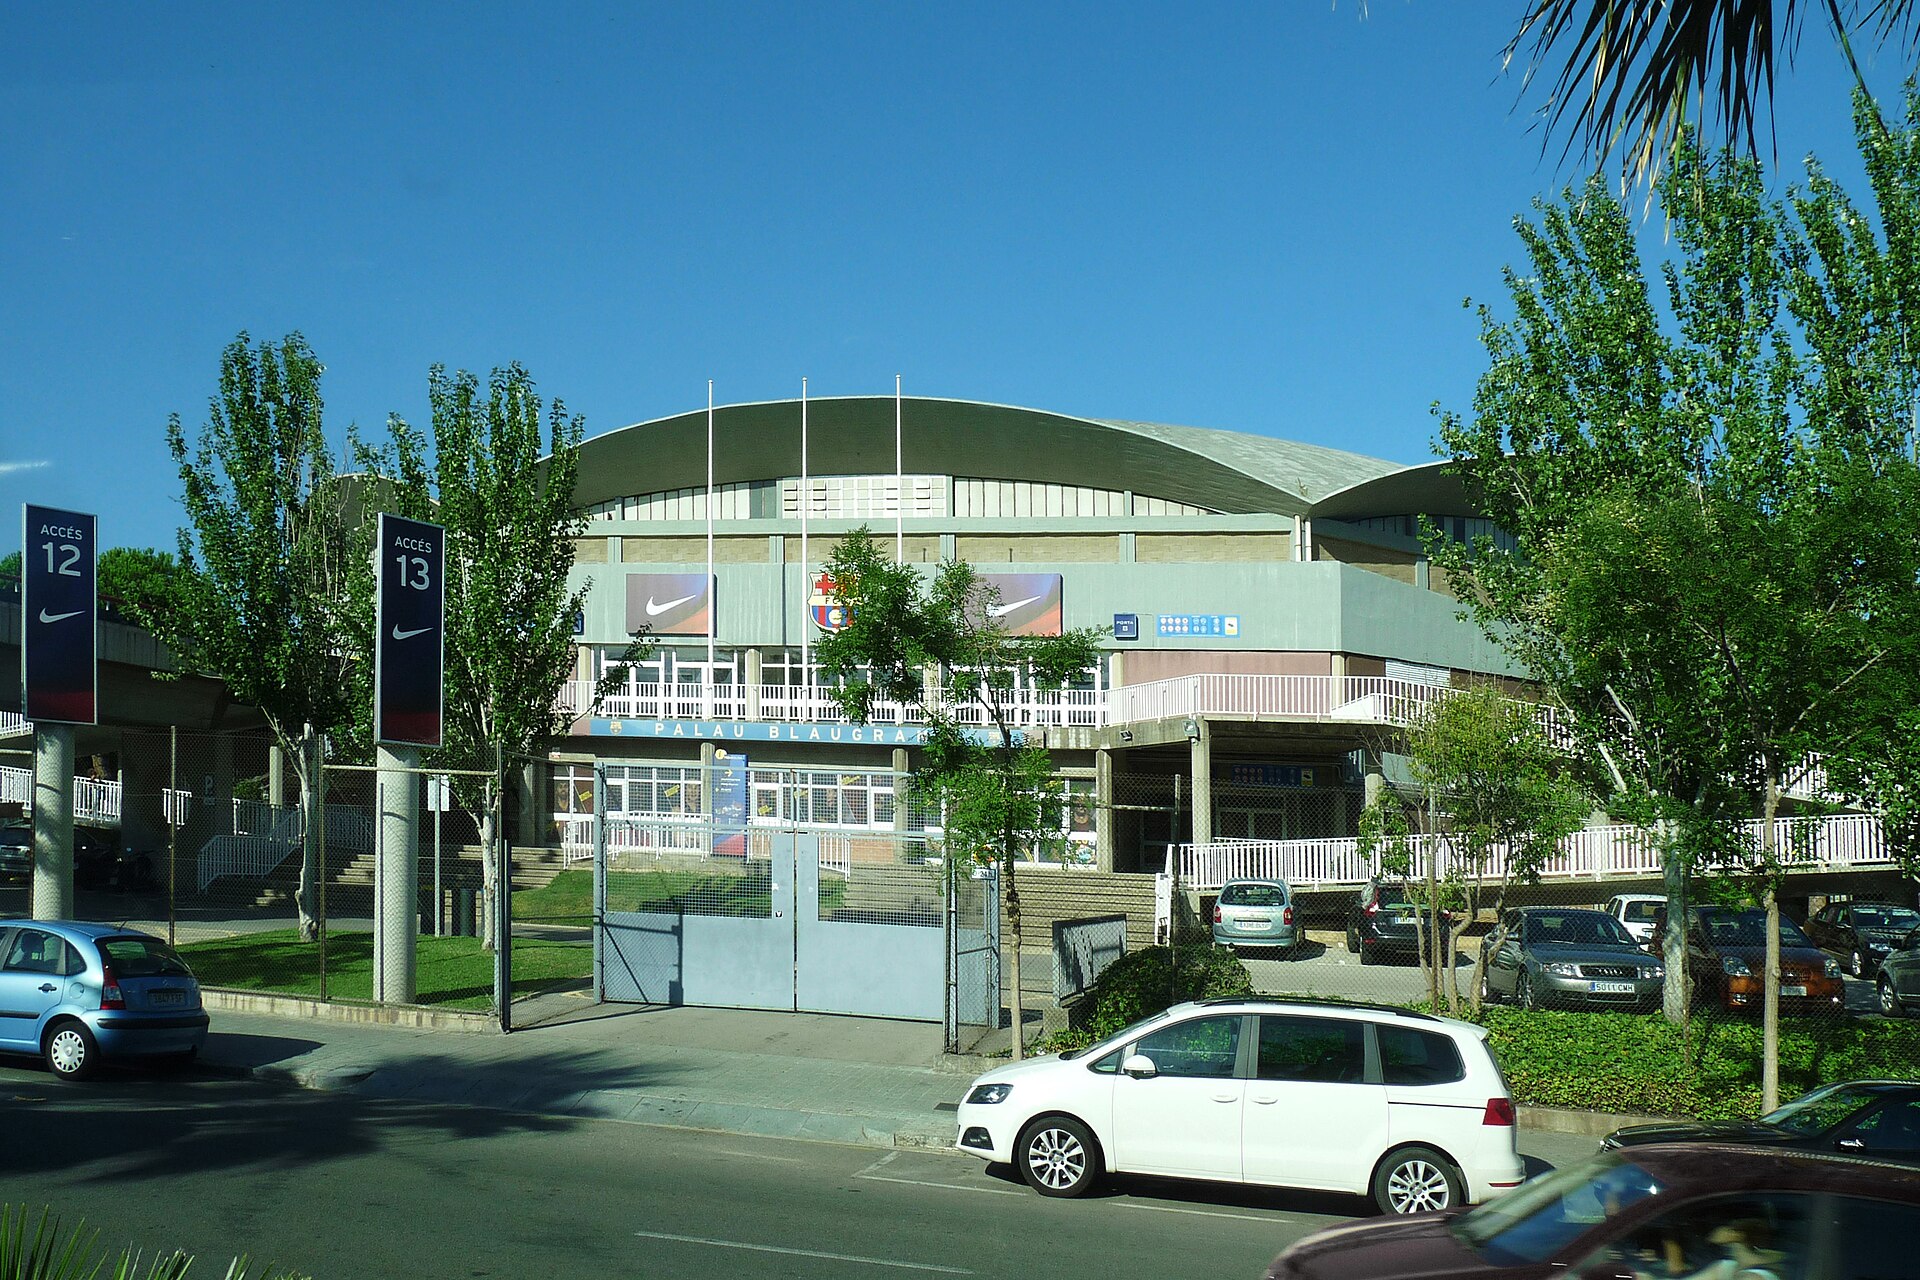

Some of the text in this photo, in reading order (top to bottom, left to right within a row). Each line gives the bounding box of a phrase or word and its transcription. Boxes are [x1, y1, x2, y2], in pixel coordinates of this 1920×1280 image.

[40, 524, 83, 540] ACCÉS
[394, 535, 432, 553] ACCÉS
[42, 541, 81, 577] 12
[396, 554, 430, 590] 13
[655, 722, 938, 744] PALAU BLAUGRAN
